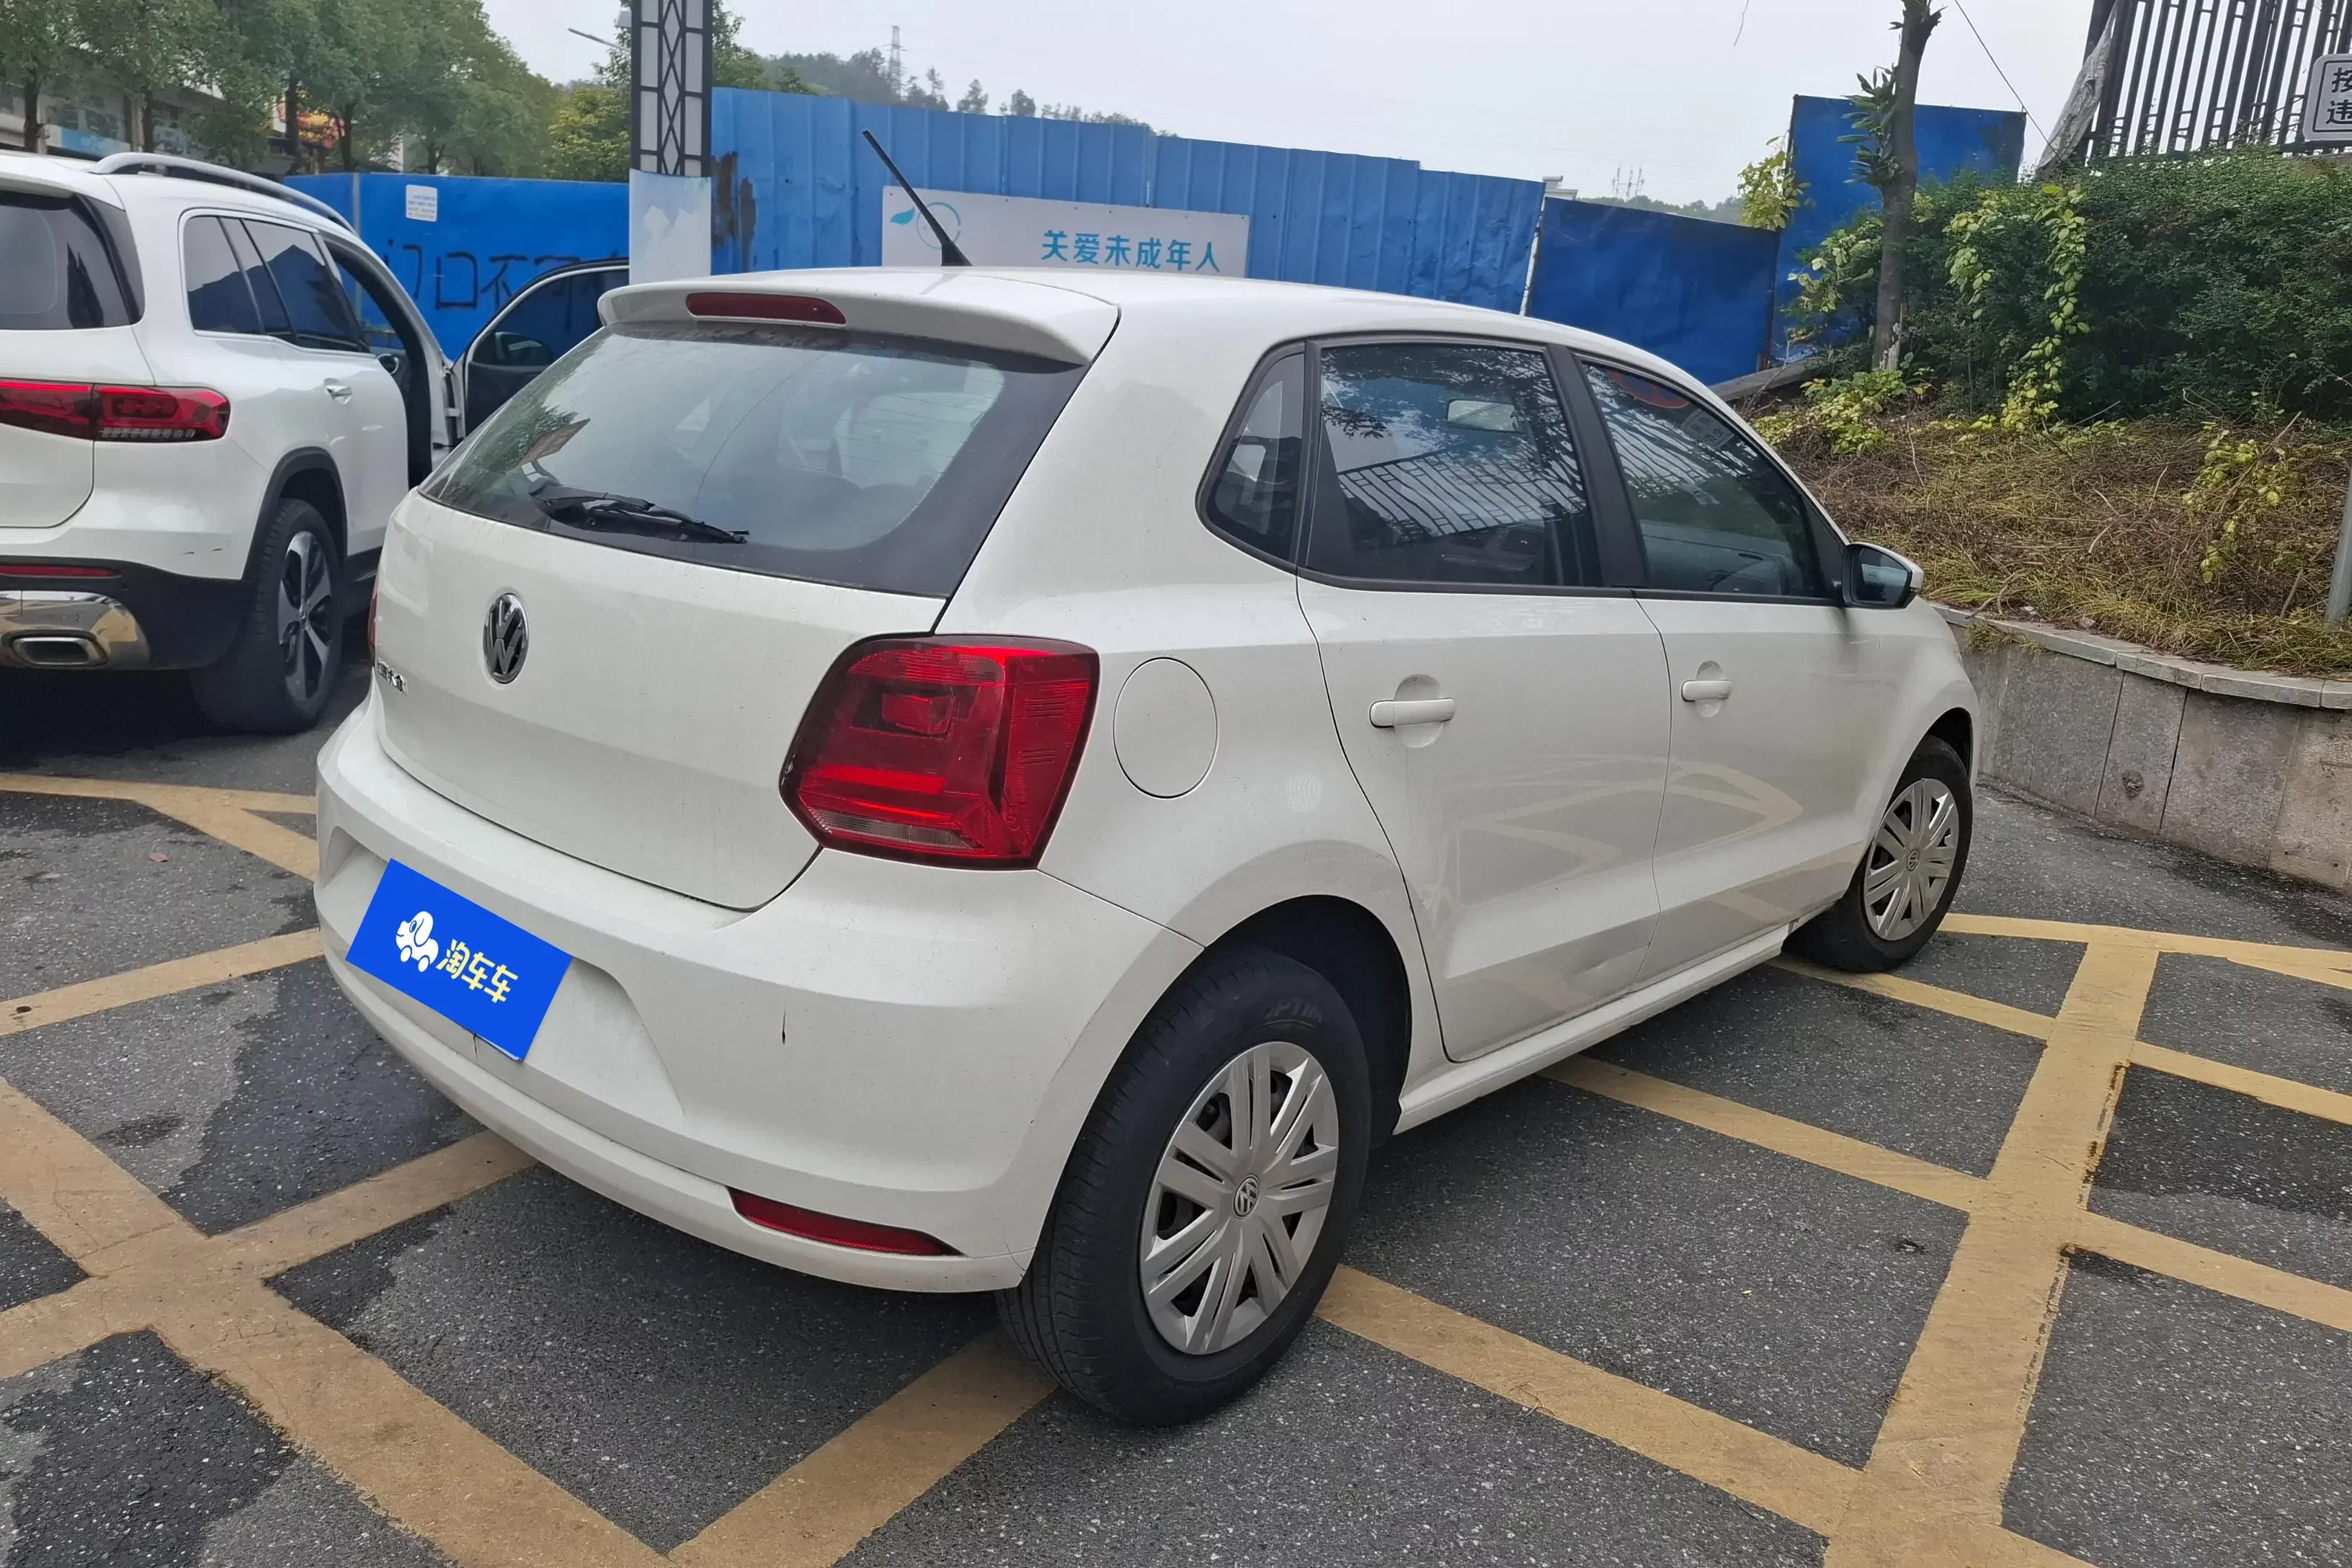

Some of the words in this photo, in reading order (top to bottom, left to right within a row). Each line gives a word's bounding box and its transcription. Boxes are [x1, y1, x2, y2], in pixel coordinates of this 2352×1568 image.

[1041, 230, 1221, 272] 关爱未成年人
